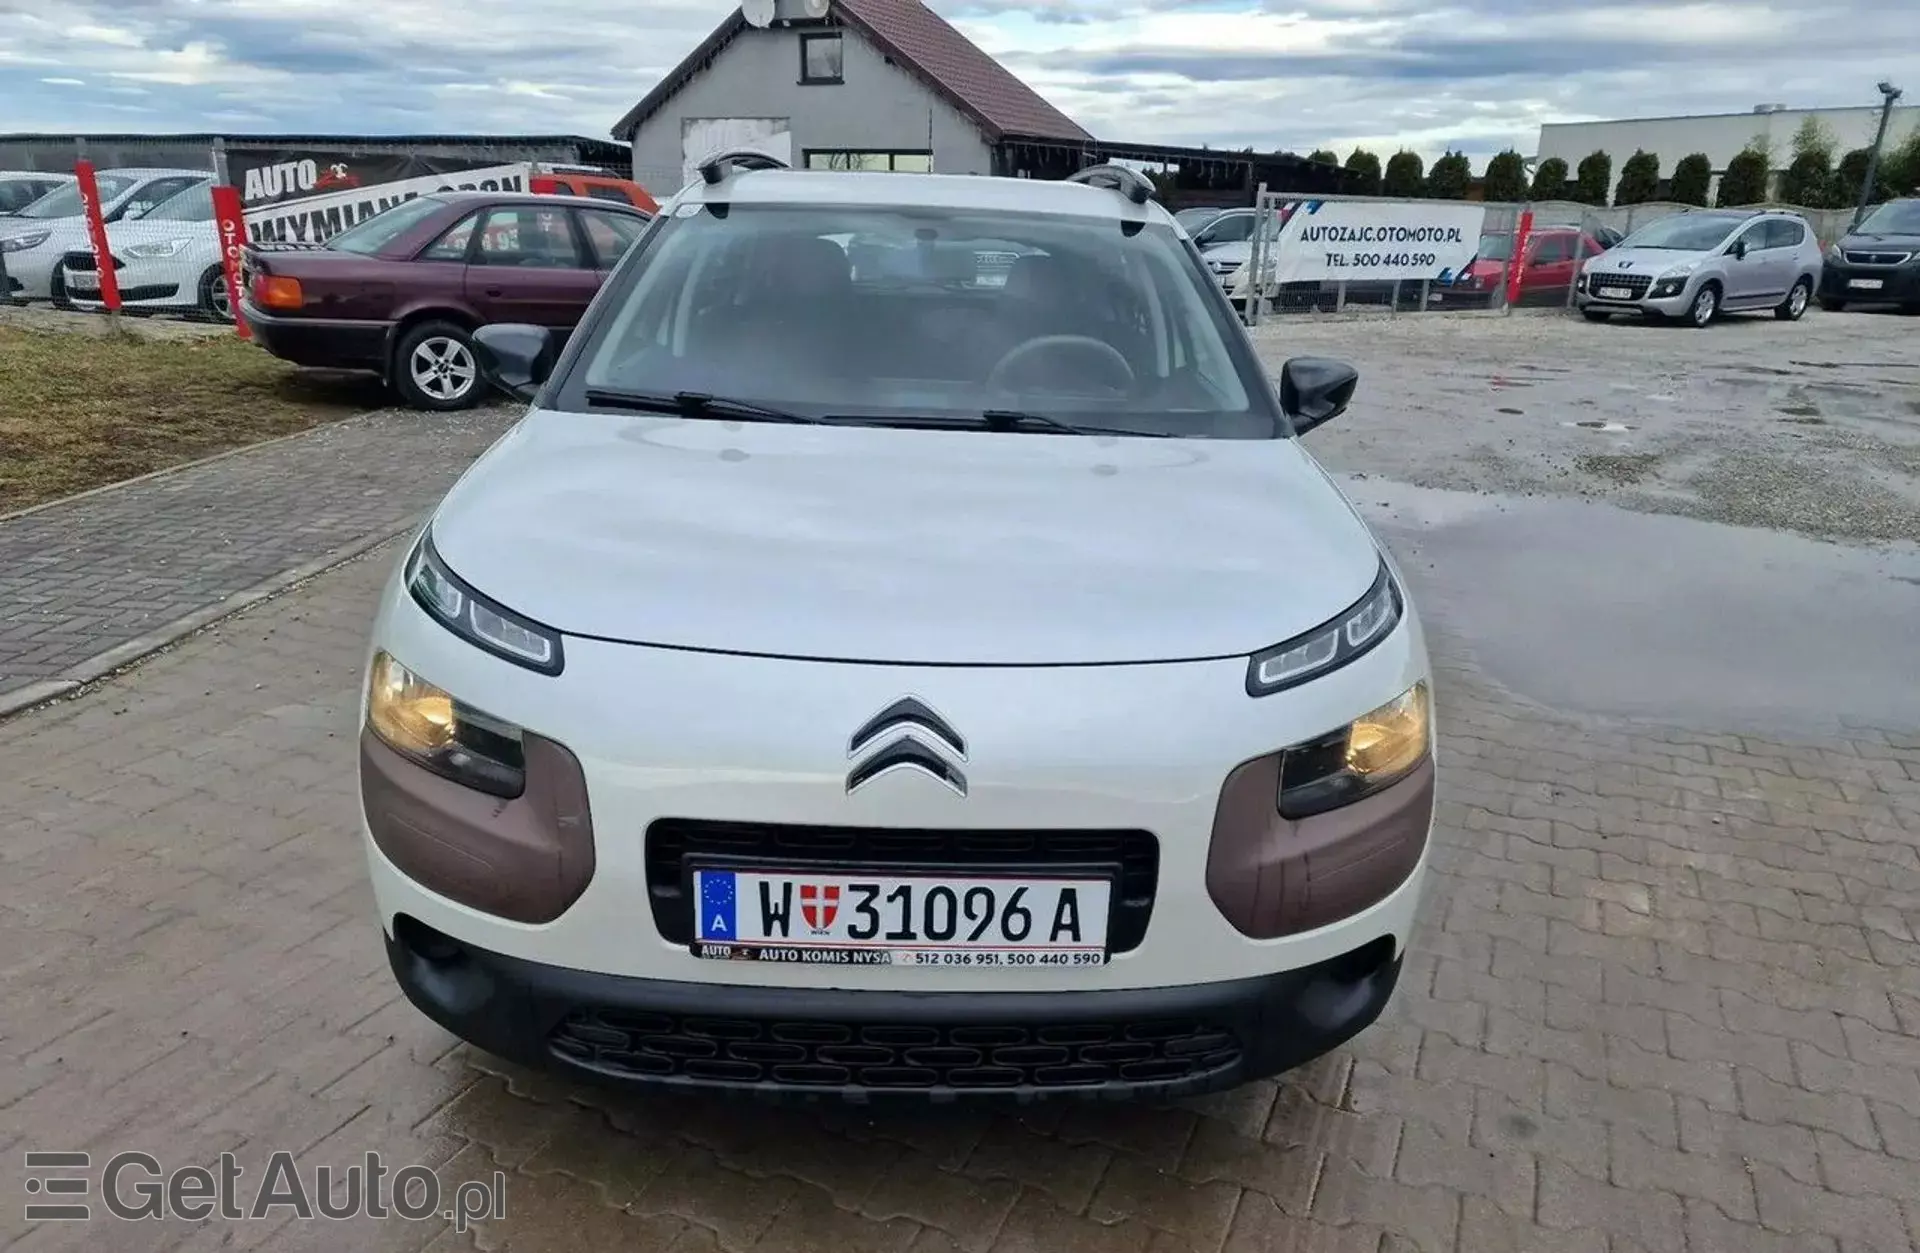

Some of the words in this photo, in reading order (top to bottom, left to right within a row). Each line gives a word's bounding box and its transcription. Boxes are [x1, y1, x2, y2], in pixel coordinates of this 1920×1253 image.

[244, 159, 317, 201] AUTO
[1300, 226, 1462, 243] AUTOZAJC.OTOMOTO.PL
[1326, 253, 1350, 267] TEL.
[1353, 253, 1380, 267] 500
[1383, 253, 1409, 267] 440
[1411, 253, 1436, 267] 590
[758, 881, 793, 937] W
[847, 884, 1032, 943] 31096
[1049, 887, 1082, 942] A
[711, 914, 727, 932] A
[701, 944, 731, 957] AUTO
[759, 948, 798, 961] AUTO
[802, 950, 849, 963] KOMIS
[853, 951, 891, 964] NYSA
[916, 953, 940, 965] 512
[944, 953, 972, 965] 036
[1007, 953, 1035, 965] 500
[1039, 953, 1069, 965] 440
[1073, 953, 1101, 965] 590
